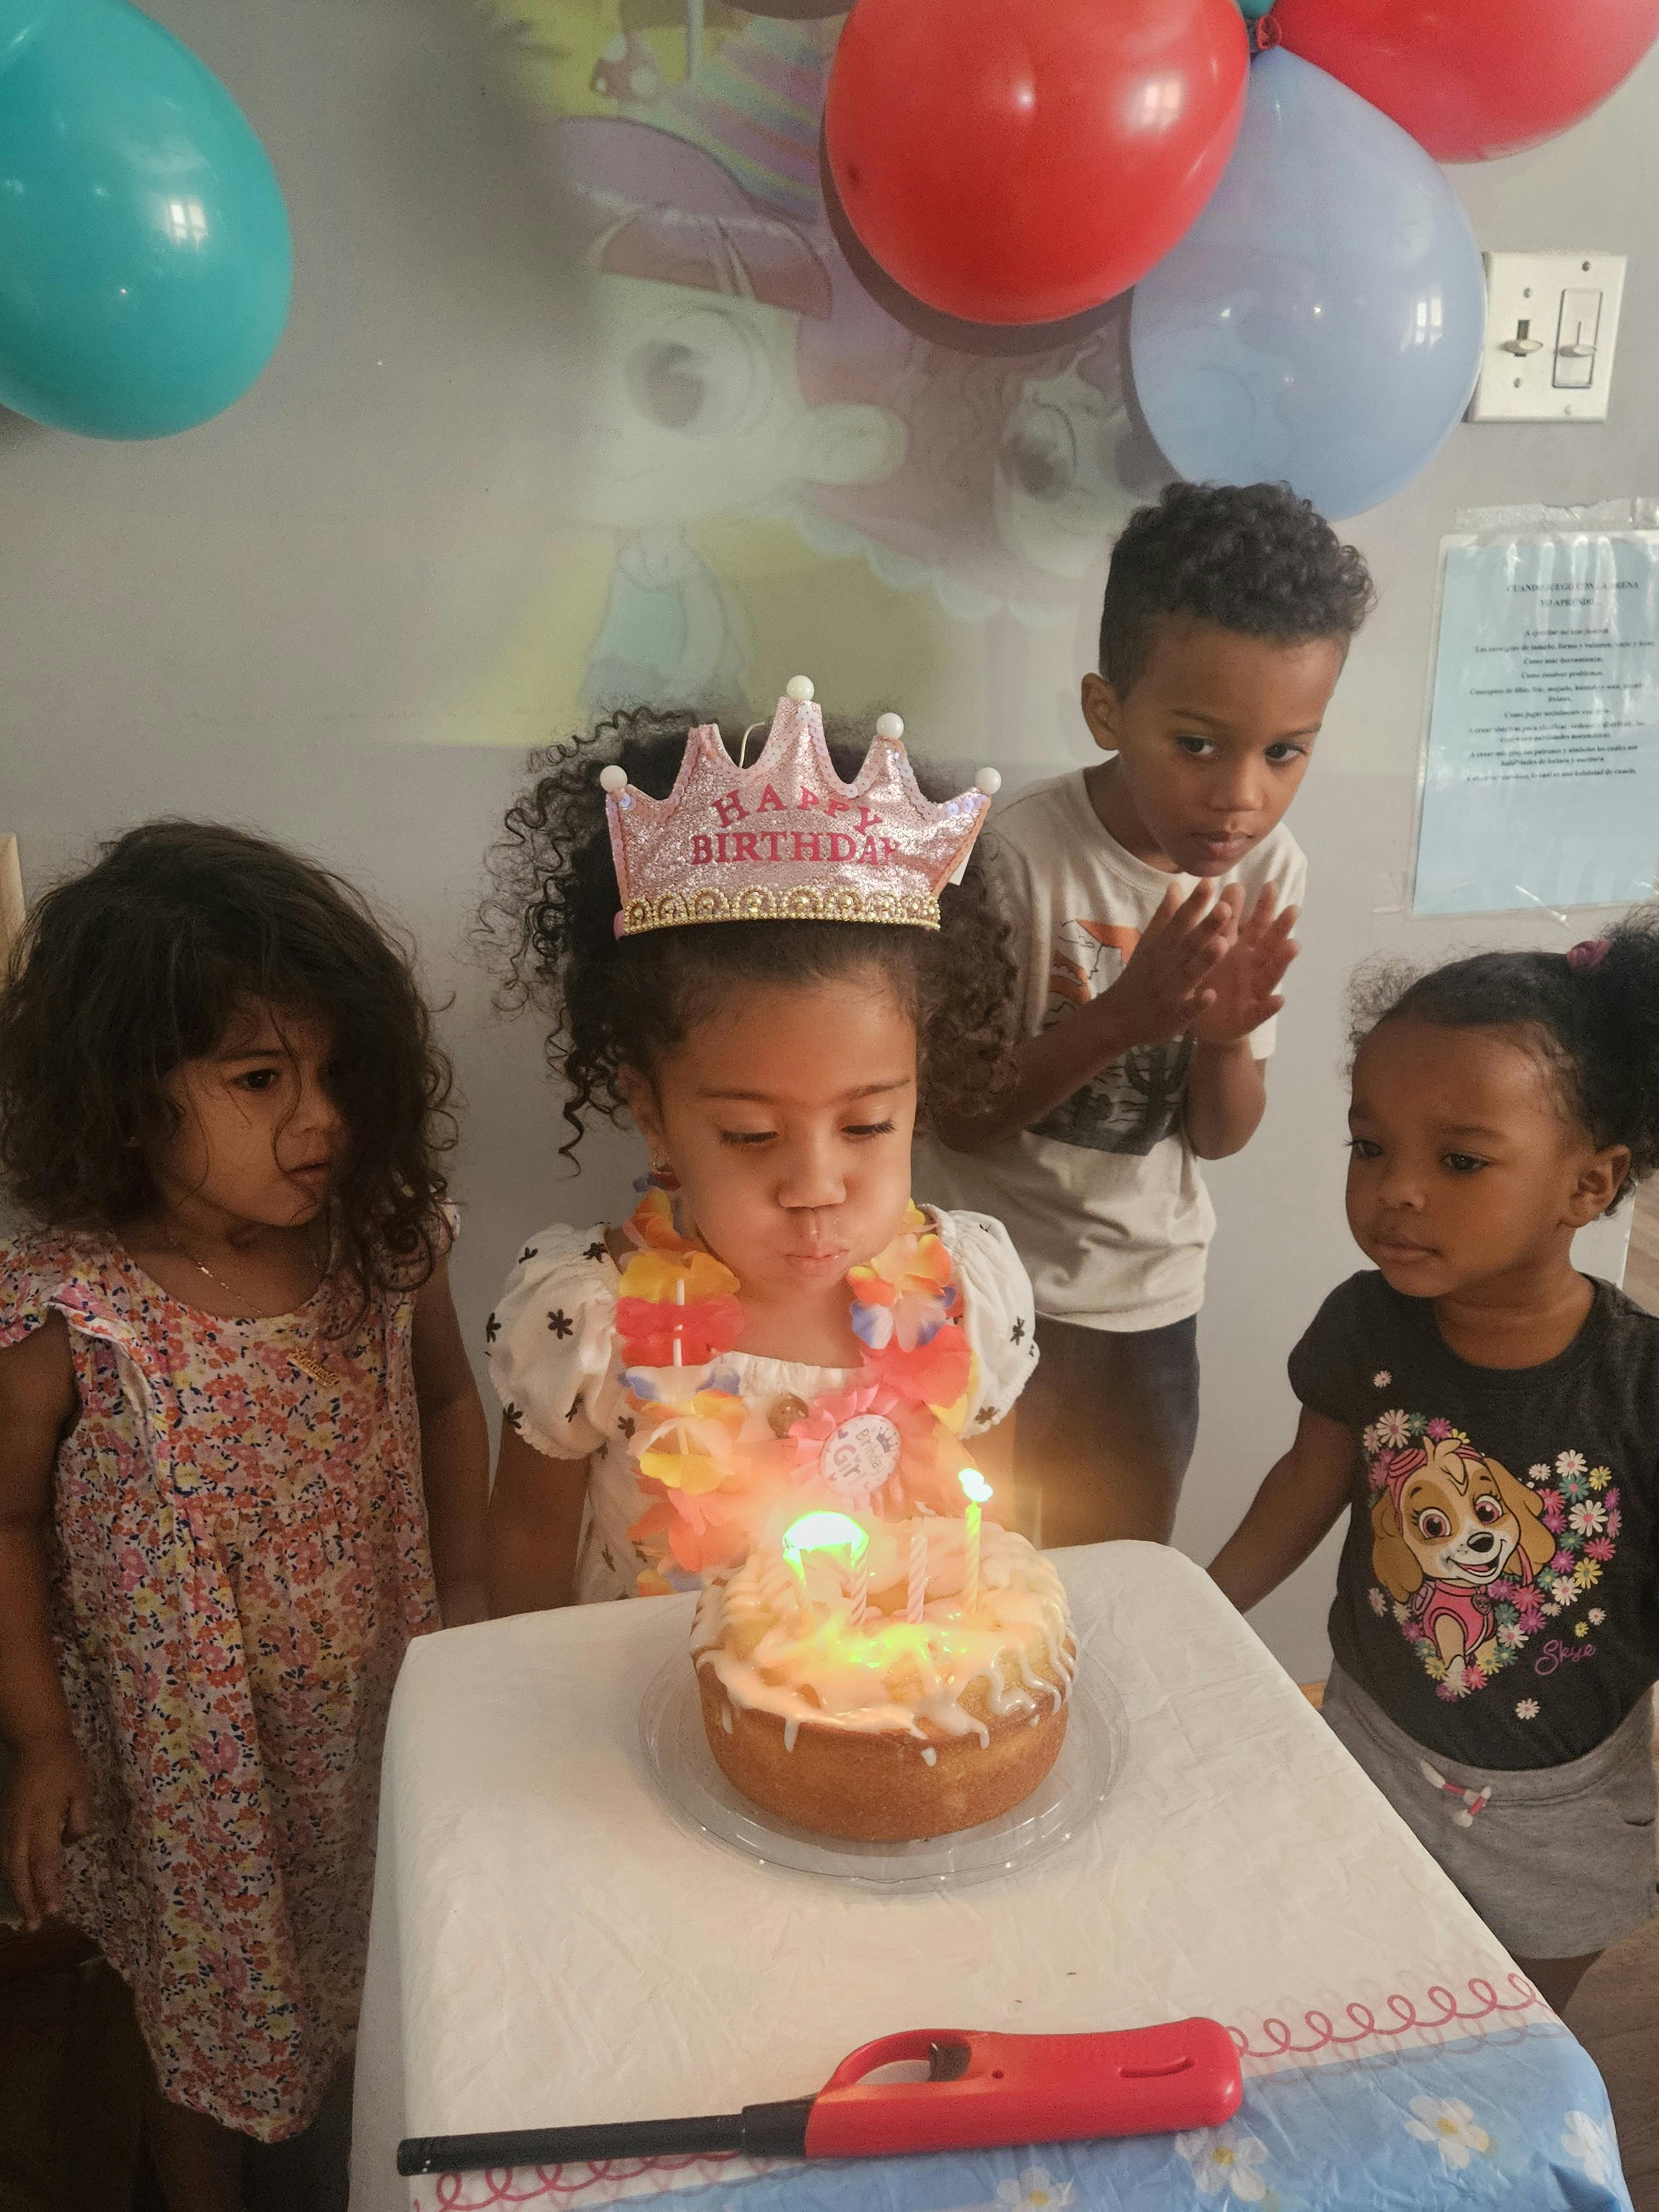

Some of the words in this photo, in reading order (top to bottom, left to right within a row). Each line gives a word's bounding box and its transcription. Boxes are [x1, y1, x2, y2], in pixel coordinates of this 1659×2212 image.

[1545, 582, 1573, 591] UEGO
[1609, 580, 1640, 589] RENA
[1521, 643, 1530, 651] de
[709, 782, 883, 836] HAPPY
[691, 831, 900, 867] BIRTHDAY
[833, 1444, 868, 1486] Girl
[1534, 1639, 1597, 1676] Skye
